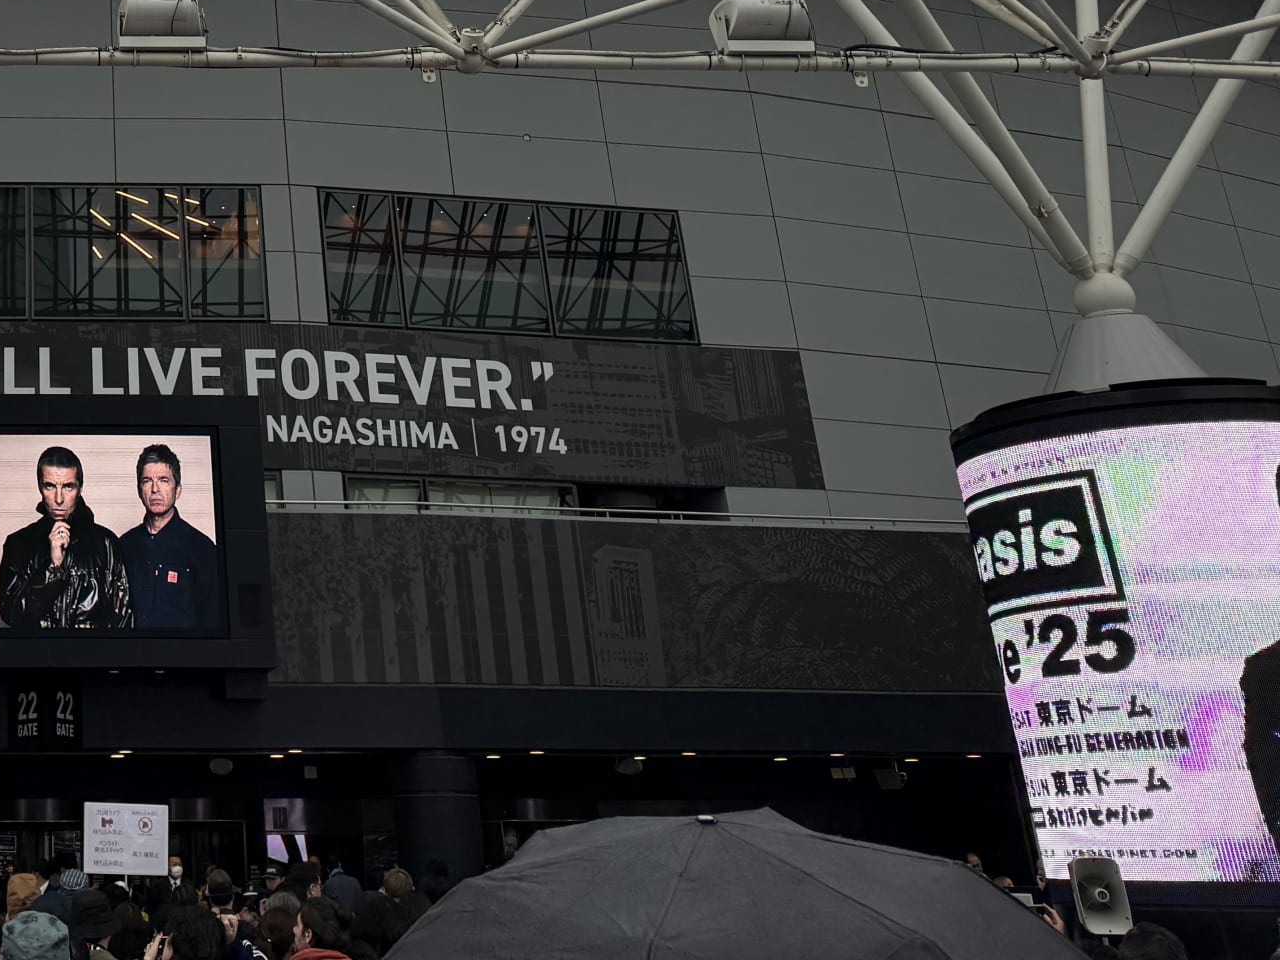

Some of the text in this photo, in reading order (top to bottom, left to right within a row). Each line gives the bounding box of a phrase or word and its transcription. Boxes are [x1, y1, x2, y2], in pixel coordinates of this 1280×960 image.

[91, 346, 225, 395] LIVE
[265, 414, 568, 455] NAGASHIMA 1974
[973, 508, 1081, 583] asis
[18, 691, 74, 720] 22 22
[1035, 695, 1153, 727] 東京ドーム
[17, 722, 74, 737] GATE GATE
[1051, 766, 1172, 797] 東京ドーム
